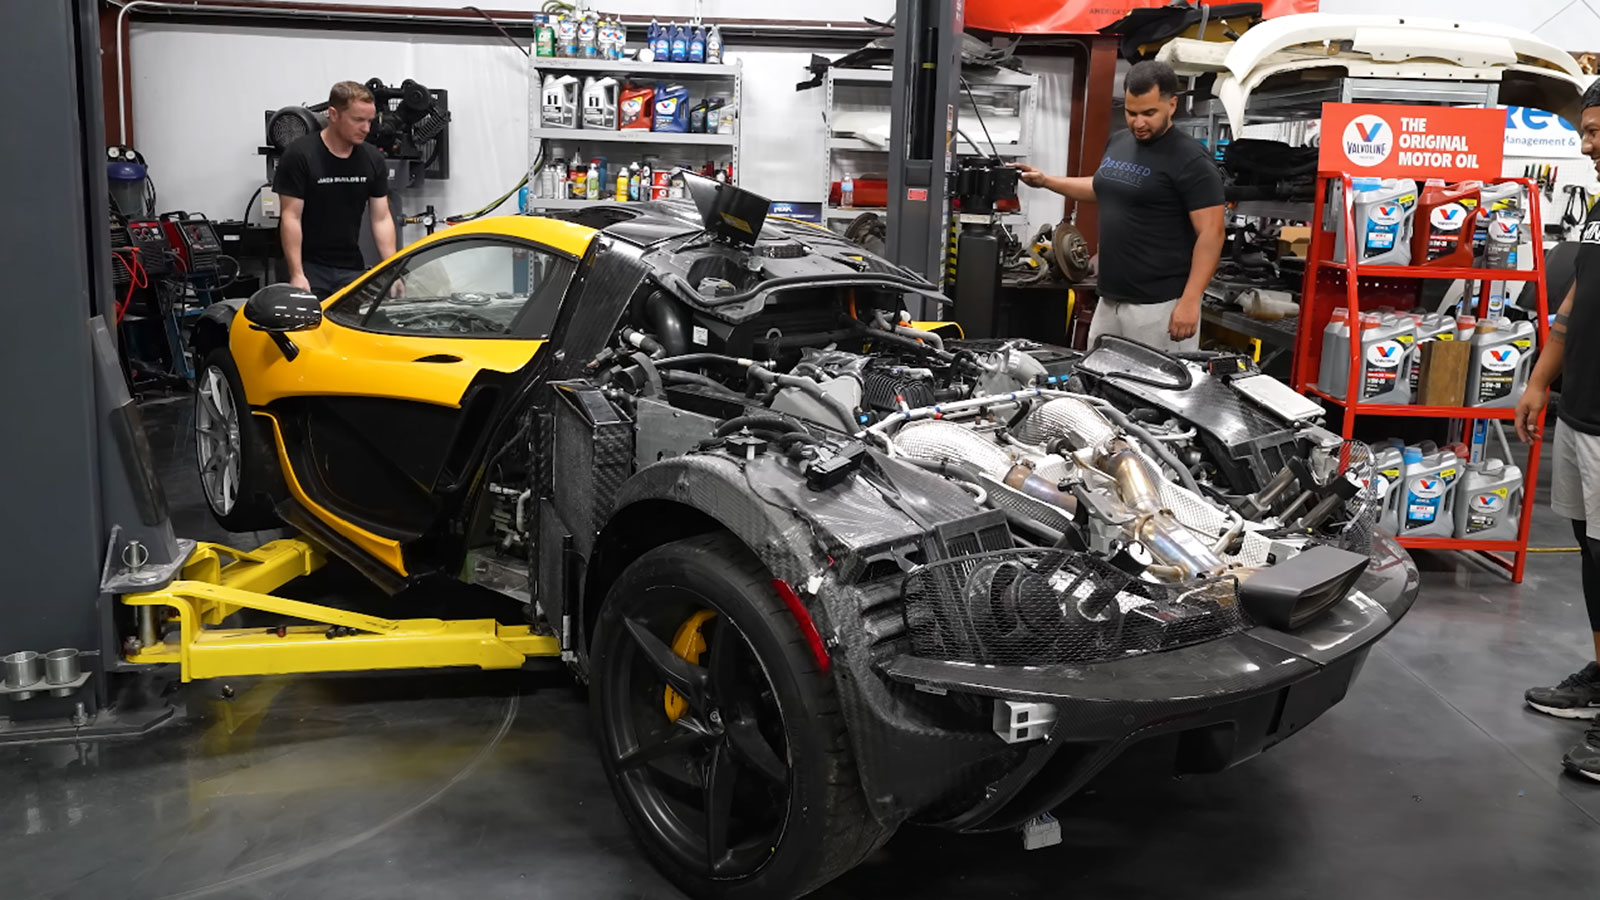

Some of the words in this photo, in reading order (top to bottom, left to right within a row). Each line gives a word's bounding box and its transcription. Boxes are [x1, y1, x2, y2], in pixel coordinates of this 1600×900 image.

[1400, 117, 1427, 132] THE
[1347, 142, 1386, 156] VALVOLINE
[1399, 134, 1468, 152] ORIGINAL
[1398, 152, 1452, 168] MOTOR
[1456, 155, 1479, 169] OIL
